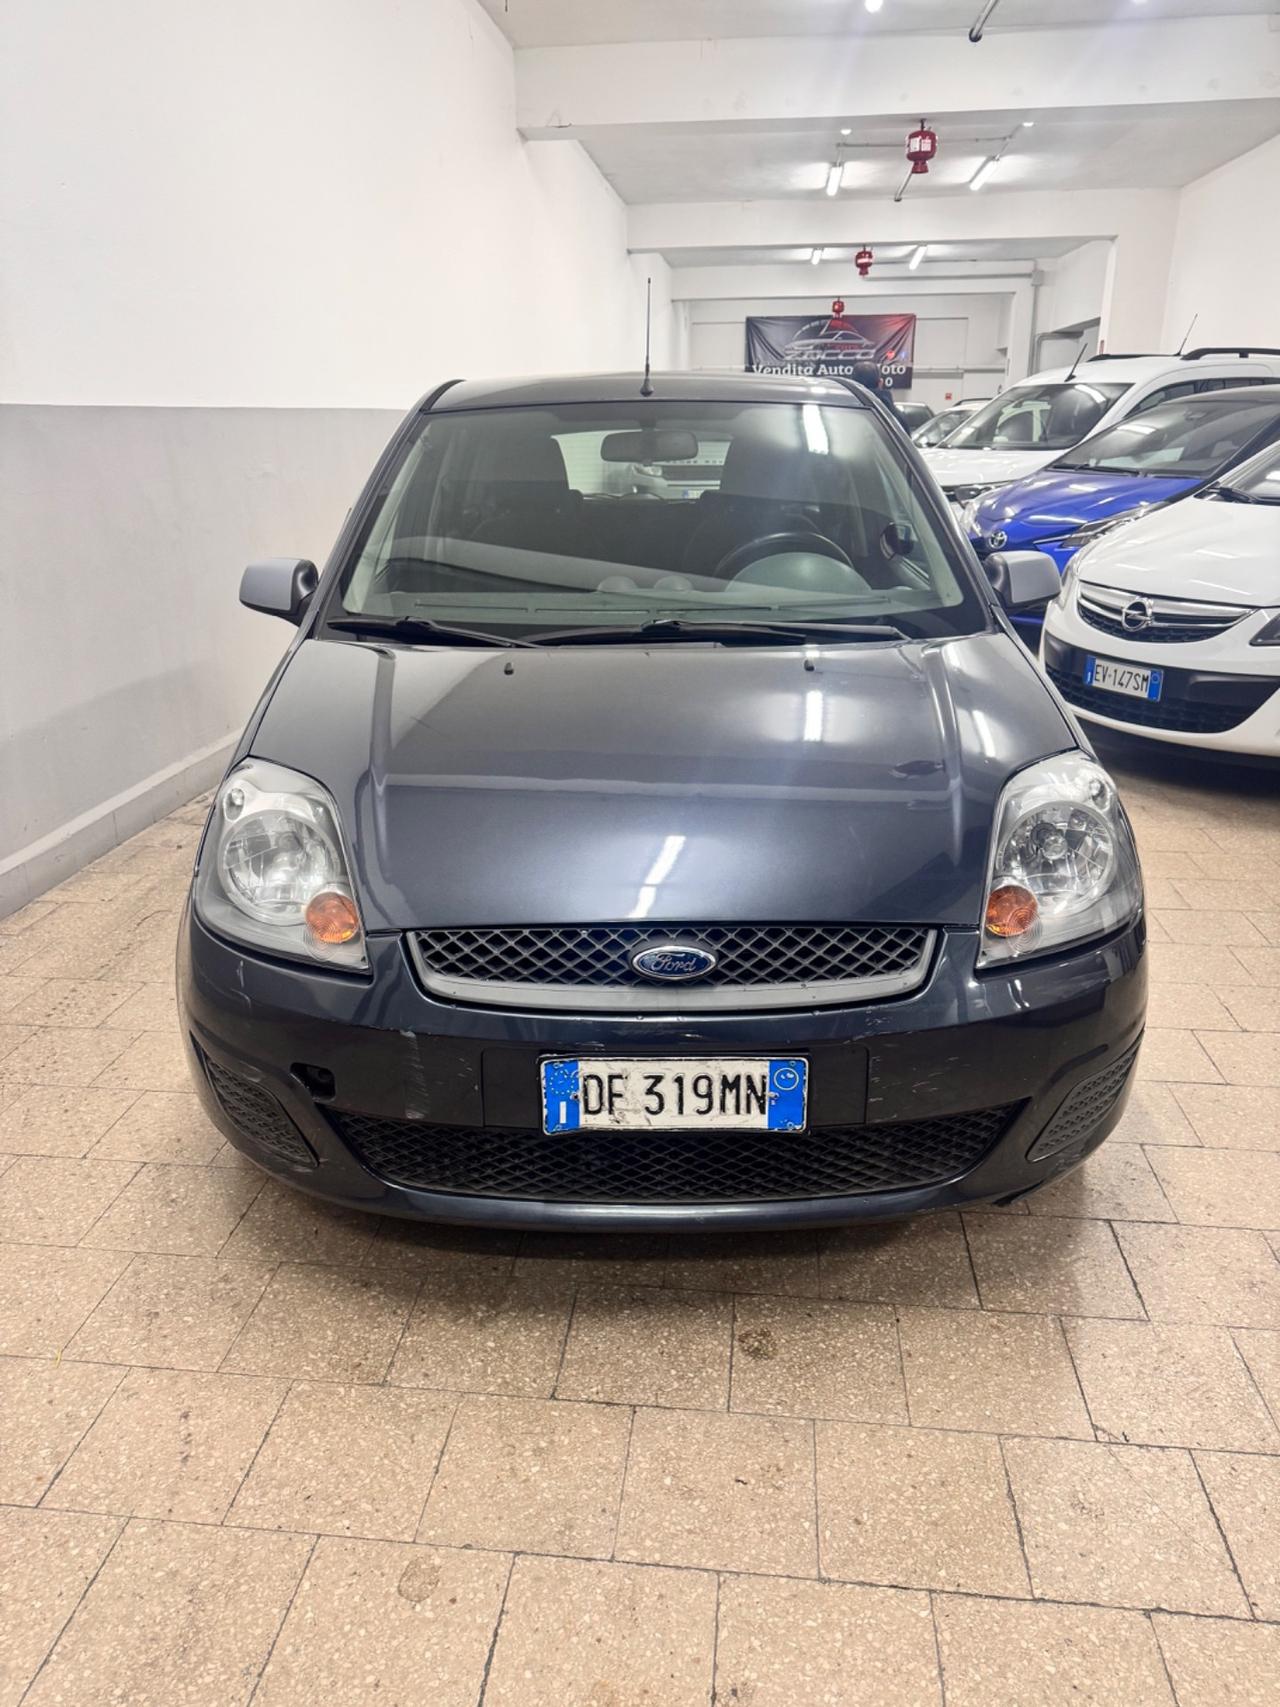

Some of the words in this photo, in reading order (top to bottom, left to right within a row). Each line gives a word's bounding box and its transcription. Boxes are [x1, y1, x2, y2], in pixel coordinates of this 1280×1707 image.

[752, 363, 813, 375] Vendita
[817, 364, 853, 375] Auto
[876, 364, 906, 375] oto
[651, 952, 697, 971] Ford
